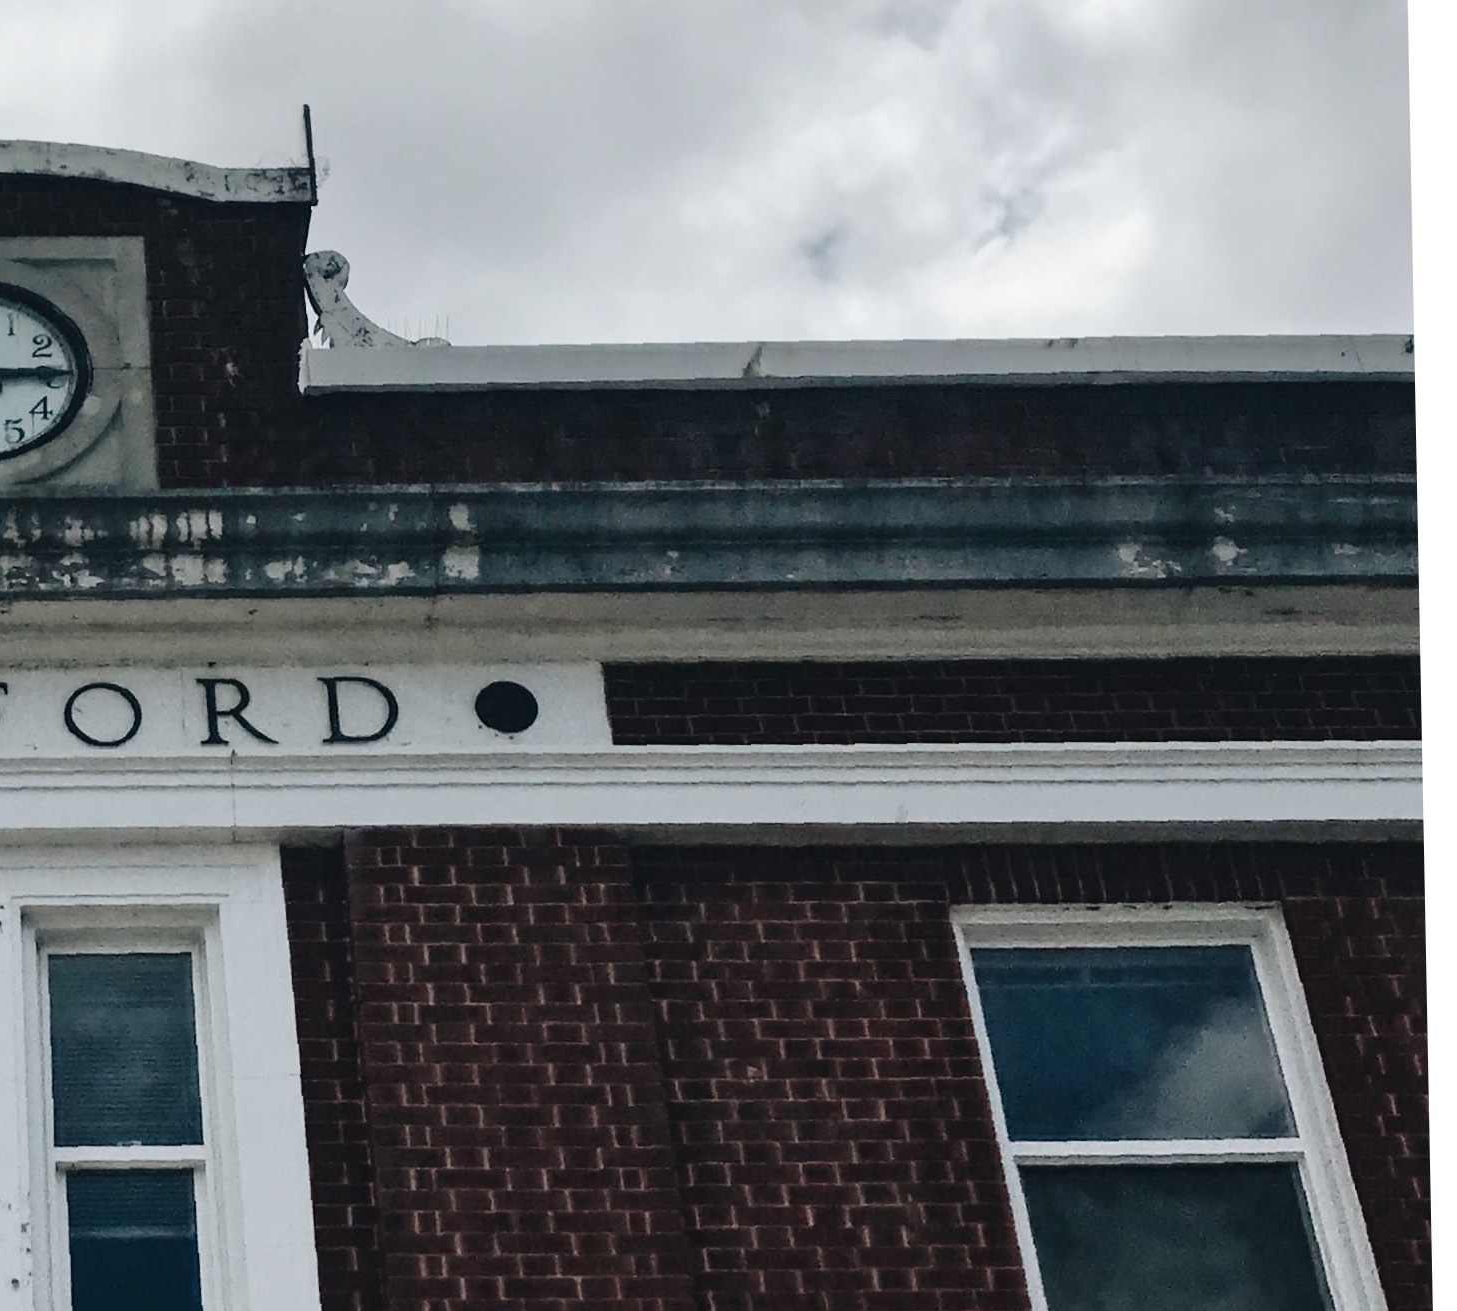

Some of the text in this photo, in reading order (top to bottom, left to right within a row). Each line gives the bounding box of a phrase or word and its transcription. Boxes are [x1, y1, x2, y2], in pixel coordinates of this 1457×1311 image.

[6, 311, 17, 337] 1
[32, 334, 53, 358] 2
[29, 395, 53, 420] 4
[4, 419, 25, 445] 5
